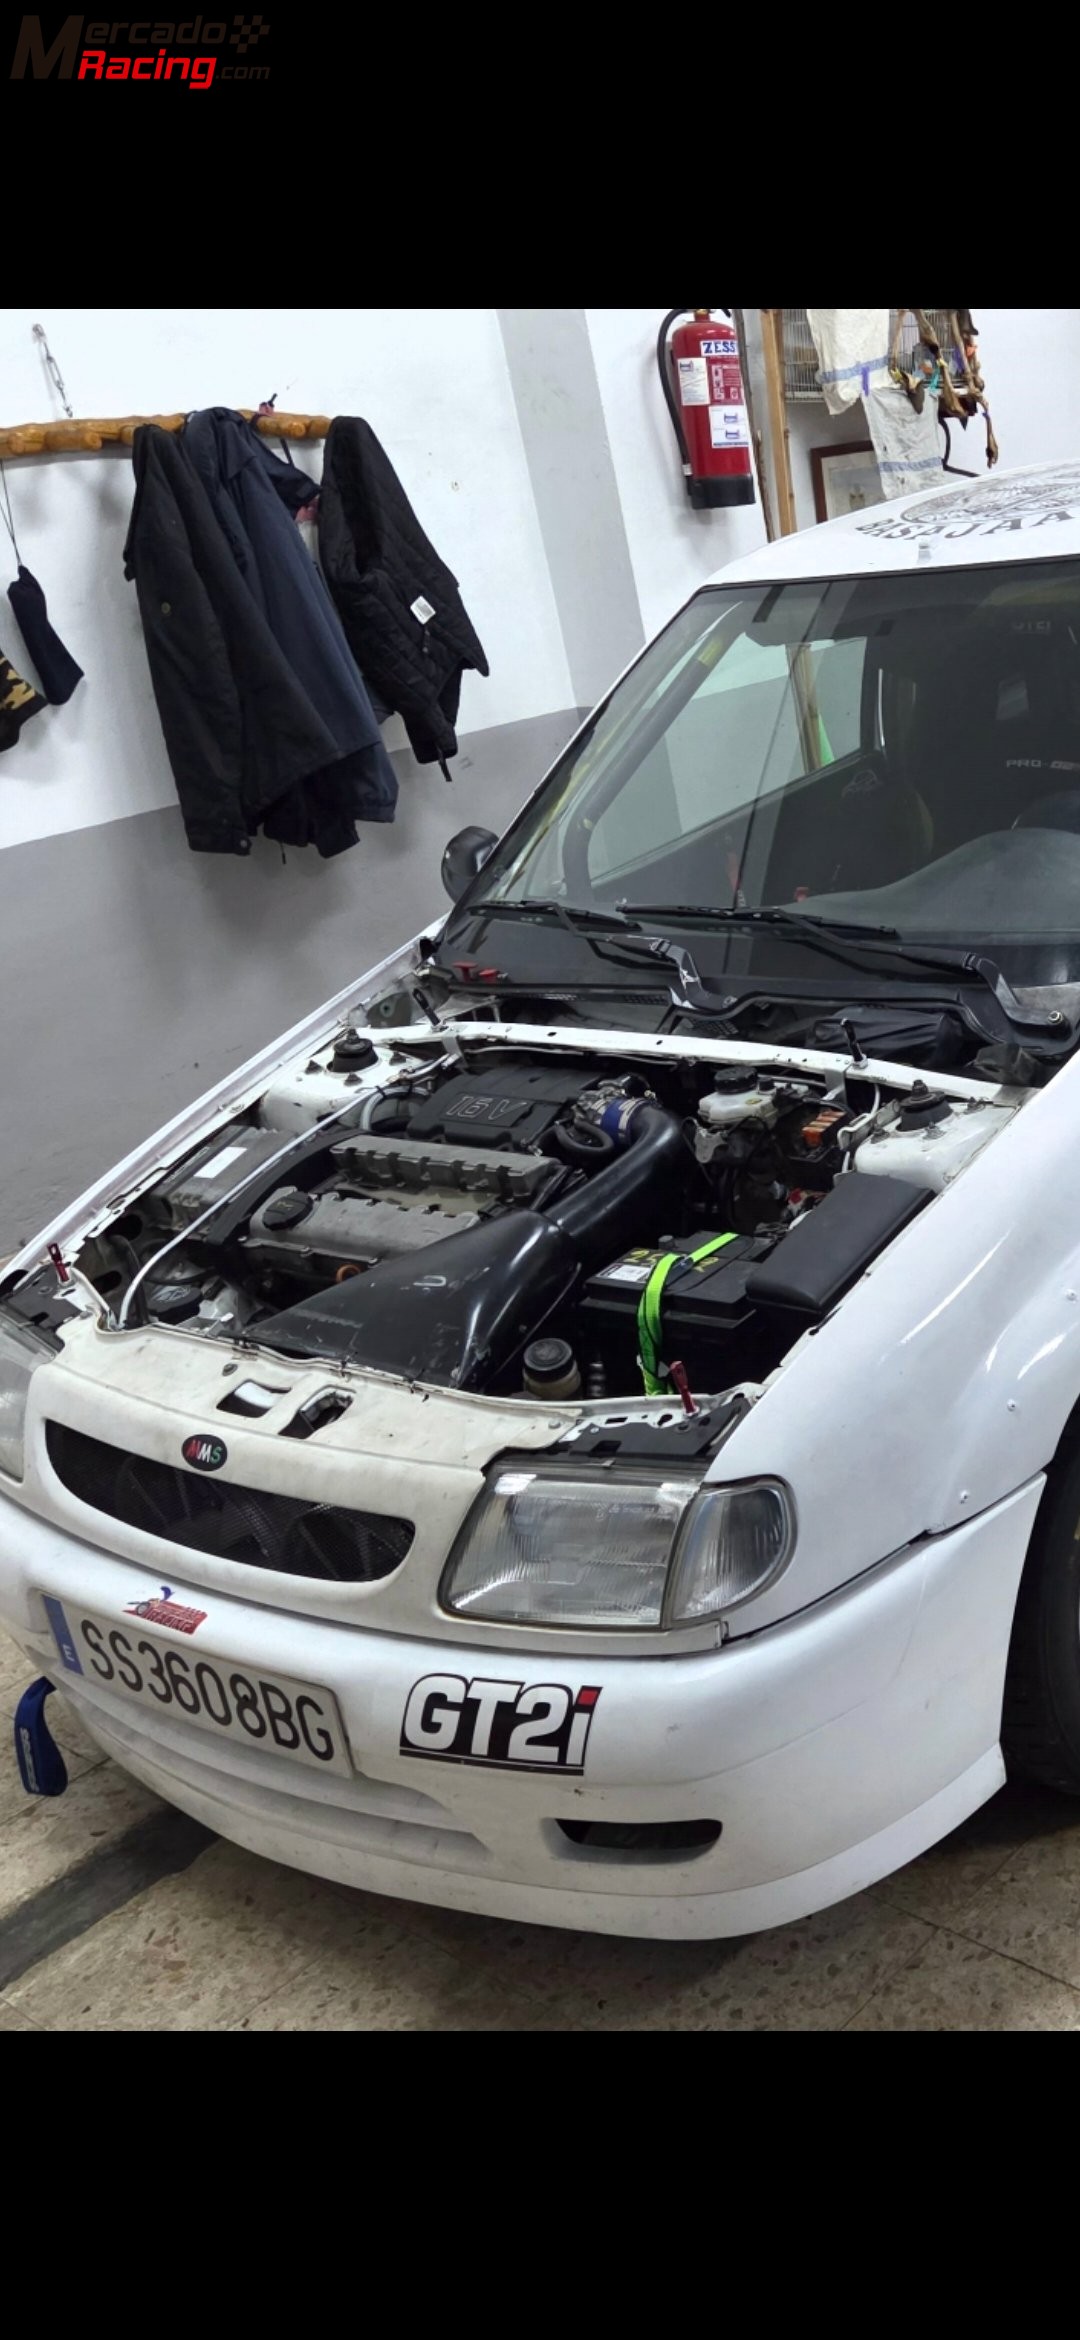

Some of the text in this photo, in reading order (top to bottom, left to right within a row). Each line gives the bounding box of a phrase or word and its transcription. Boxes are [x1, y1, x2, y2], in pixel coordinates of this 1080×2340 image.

[446, 1095, 527, 1121] 16V
[62, 1644, 75, 1662] E
[80, 1619, 335, 1761] SS3608BG
[402, 1673, 602, 1765] GT2i
